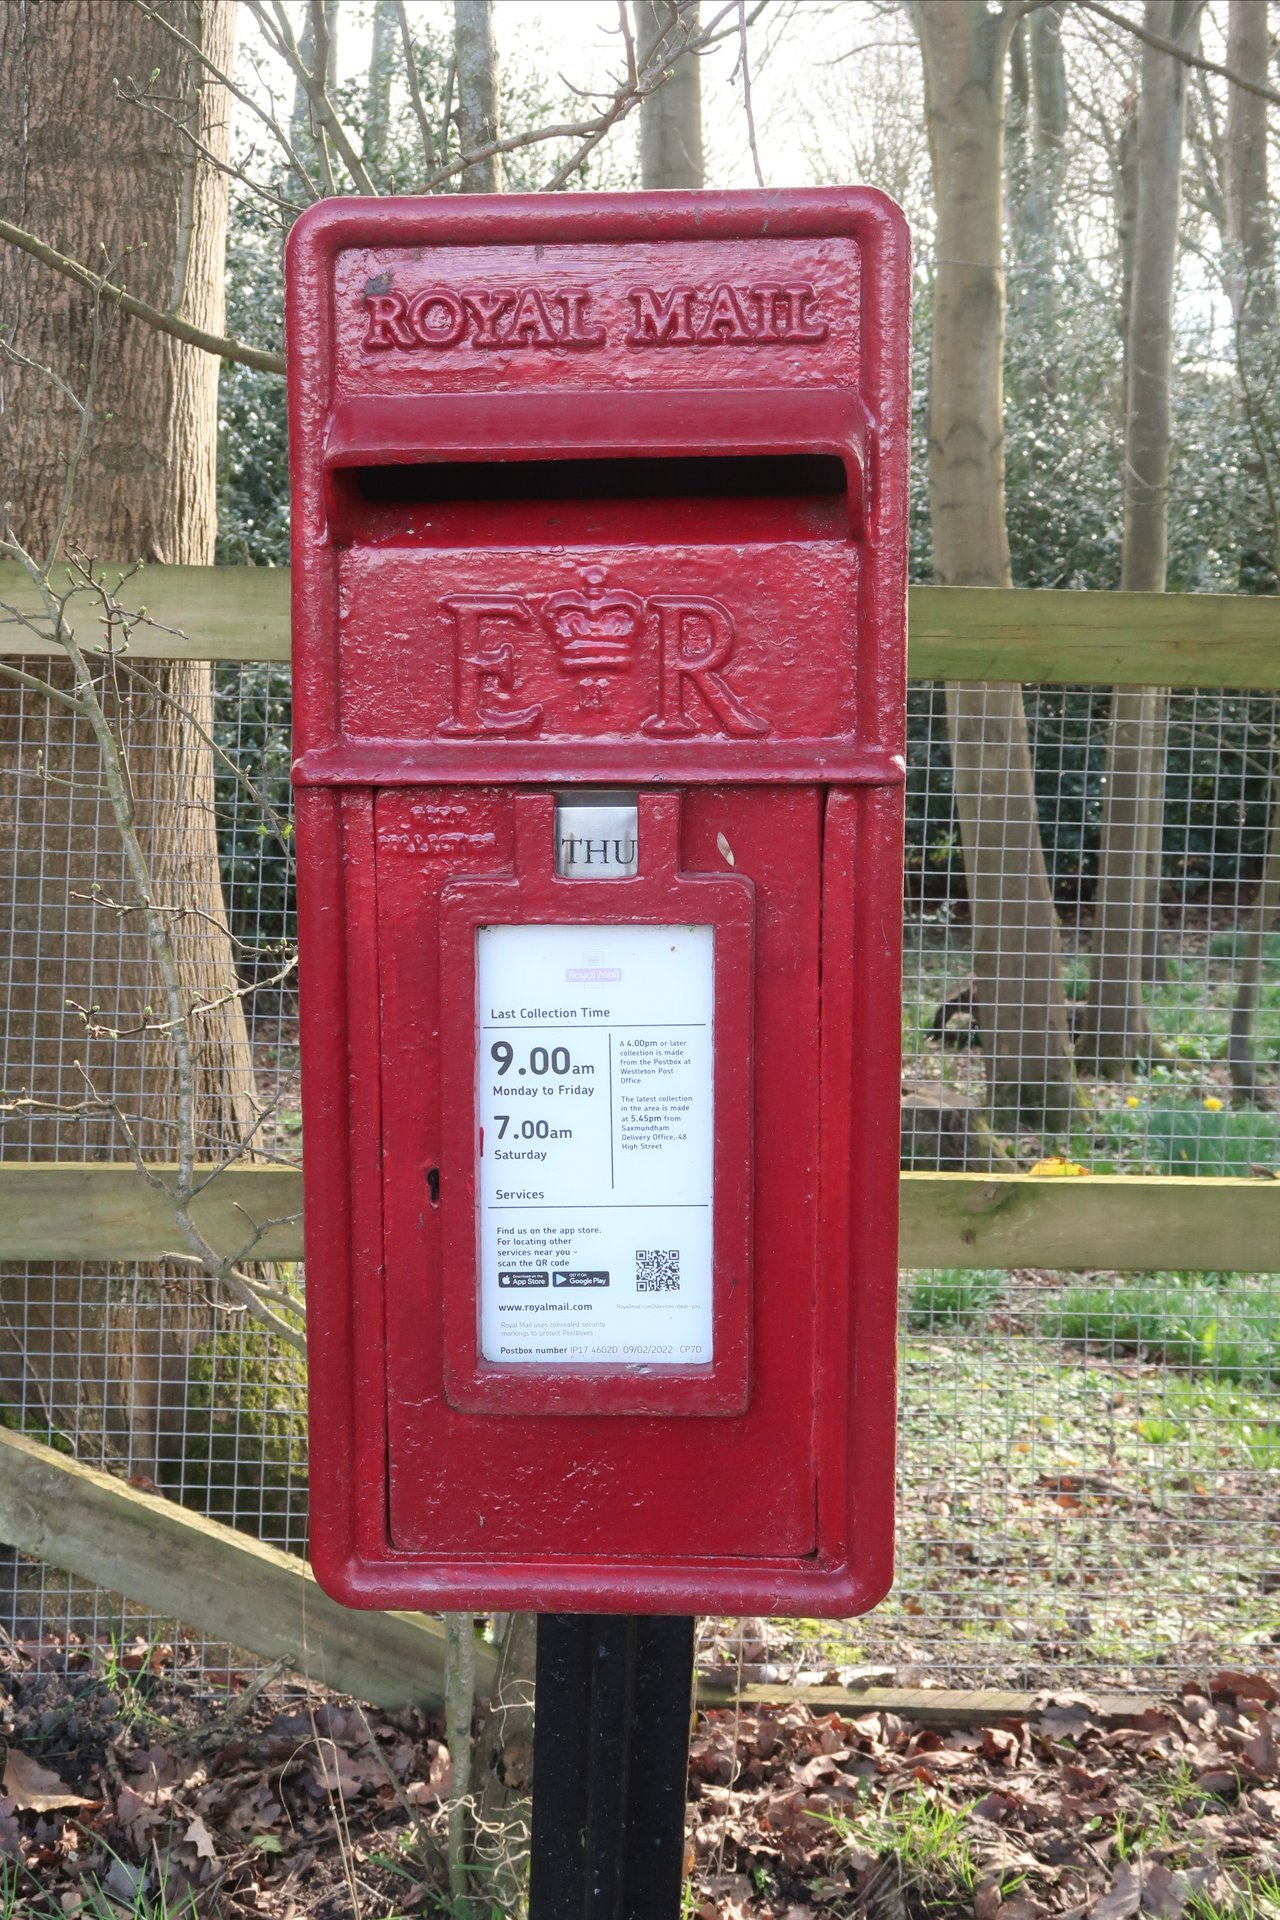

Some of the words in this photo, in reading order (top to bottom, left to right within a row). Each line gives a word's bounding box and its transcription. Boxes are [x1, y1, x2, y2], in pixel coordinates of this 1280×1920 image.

[362, 286, 607, 350] ROYAL
[627, 283, 830, 345] MAIL
[438, 593, 544, 734] E
[641, 594, 770, 735] R
[561, 837, 638, 865] THU
[568, 971, 595, 982] Royal
[598, 970, 619, 980] Mail
[491, 1009, 516, 1019] Last
[521, 1008, 577, 1019] Collection
[581, 1007, 610, 1018] Time
[627, 1040, 657, 1048] 4.00pm
[491, 1040, 595, 1076] 9.00am
[493, 1086, 538, 1097] Monday
[543, 1086, 553, 1096] to
[559, 1085, 594, 1096] Friday
[631, 1114, 661, 1123] 5.45pm
[494, 1115, 572, 1140] 7.00am
[622, 1134, 650, 1142] Delivery
[622, 1143, 637, 1151] High
[494, 1150, 546, 1162] Saturday
[496, 1189, 544, 1199] Services
[497, 1227, 514, 1235] Find
[513, 1237, 546, 1246] locating
[519, 1259, 532, 1267] the
[536, 1259, 547, 1267] QR
[513, 1278, 527, 1286] App
[569, 1277, 592, 1286] Google
[593, 1277, 606, 1286] Play
[498, 1303, 592, 1312] www.royalmail.com
[501, 1321, 517, 1329] Royal
[501, 1330, 529, 1338] markings
[501, 1346, 532, 1354] Postbox
[536, 1346, 567, 1354] number
[570, 1346, 588, 1354] IP17
[623, 1346, 672, 1354] 09/02/2022
